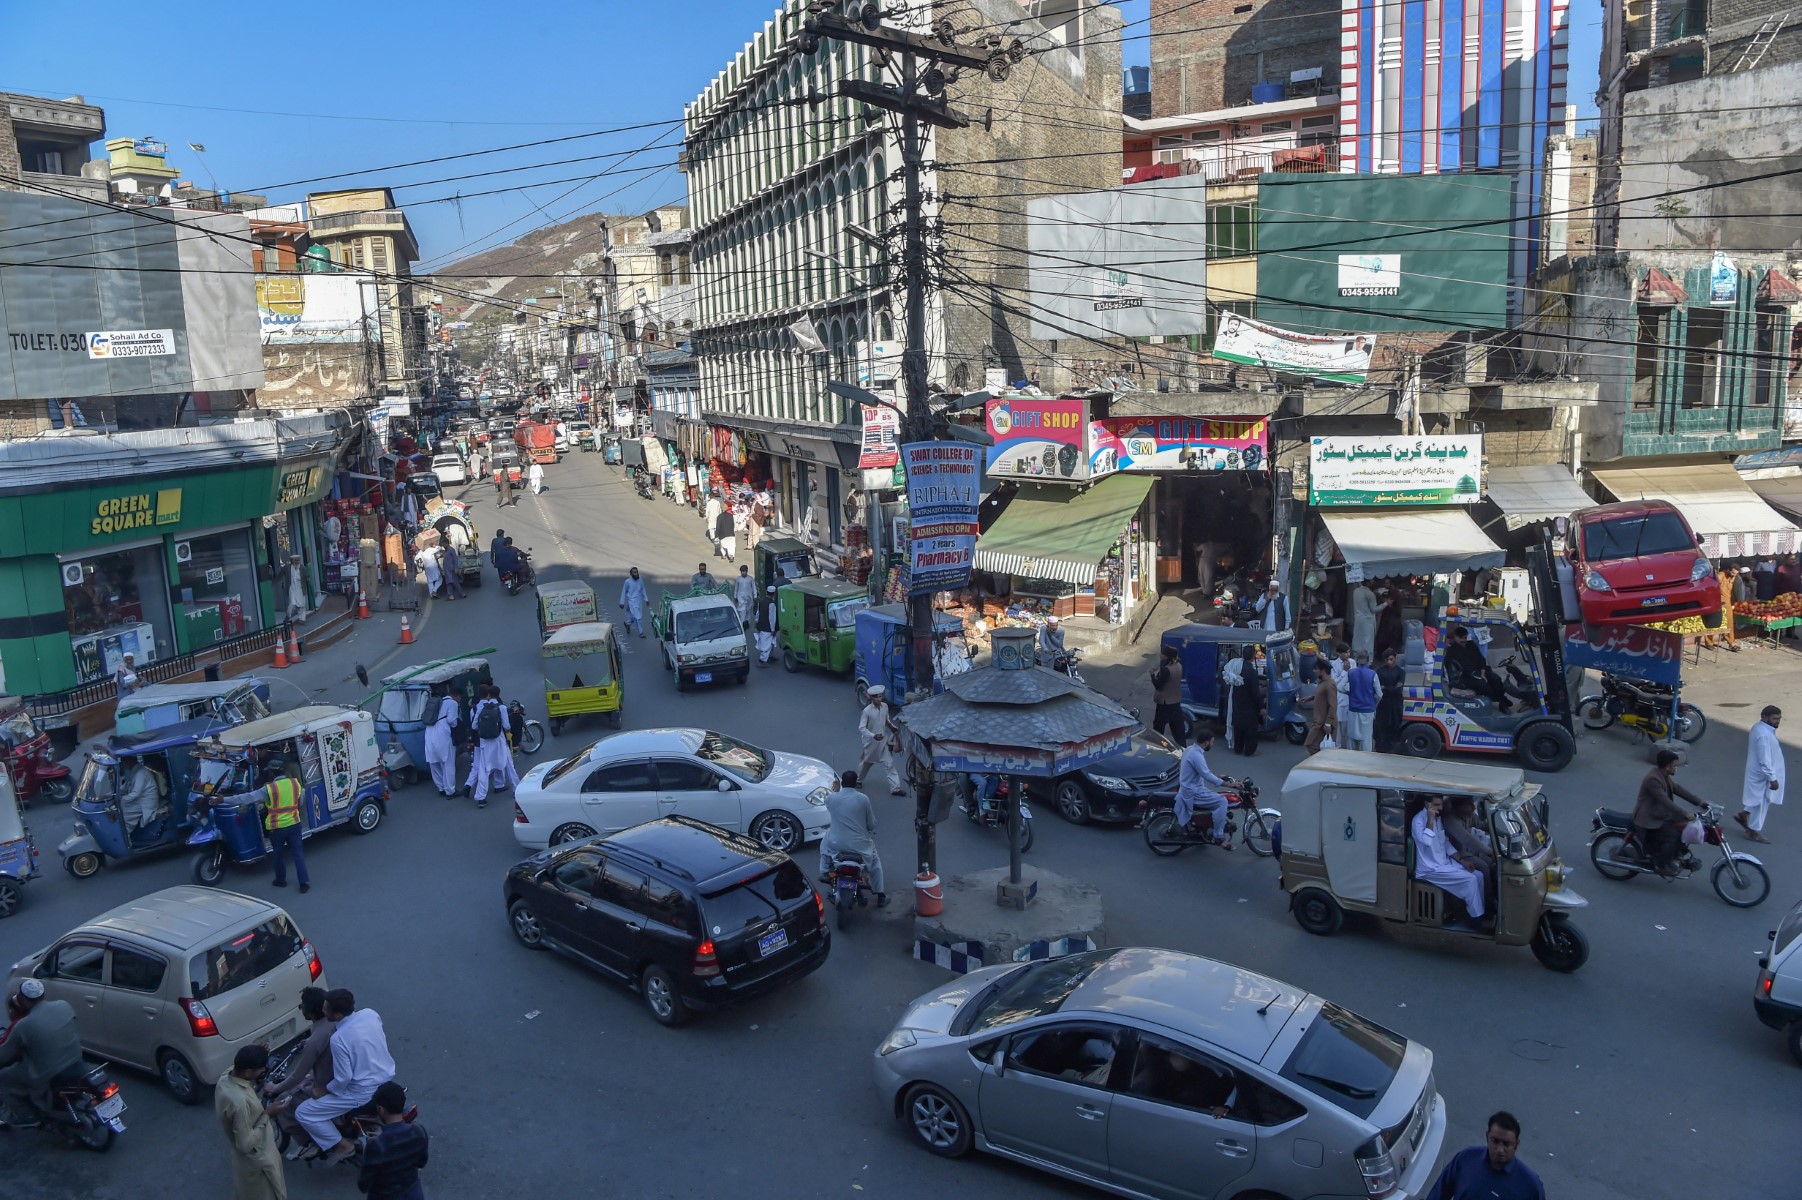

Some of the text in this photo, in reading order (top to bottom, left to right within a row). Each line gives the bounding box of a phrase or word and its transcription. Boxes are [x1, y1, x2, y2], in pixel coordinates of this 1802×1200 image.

[1341, 287, 1398, 297] 0345-9554141
[9, 333, 28, 351] TO
[60, 333, 87, 351] 030
[110, 333, 136, 341] Sohail
[112, 344, 166, 356] 0333-9072333
[1012, 411, 1041, 427] GIFT
[1044, 412, 1080, 429] SHOP
[1159, 420, 1265, 441] GIFT SHOP
[910, 448, 973, 461] SWAT COLLEGE OF
[1131, 440, 1152, 455] SM
[1316, 443, 1346, 462] سٹور
[1347, 444, 1392, 462] کیمیکل
[1394, 441, 1423, 462] گرین
[911, 464, 933, 476] SCIENCE
[98, 494, 150, 517] GREEN
[91, 510, 153, 534] SQUARE
[157, 511, 180, 522] mart
[916, 525, 954, 537] ADMISSIONS
[932, 540, 936, 549] 2
[937, 539, 956, 549] Years
[916, 550, 962, 568] Pharmacy
[1618, 635, 1673, 664] داخلہ
[1553, 650, 1563, 675] TOYOTA
